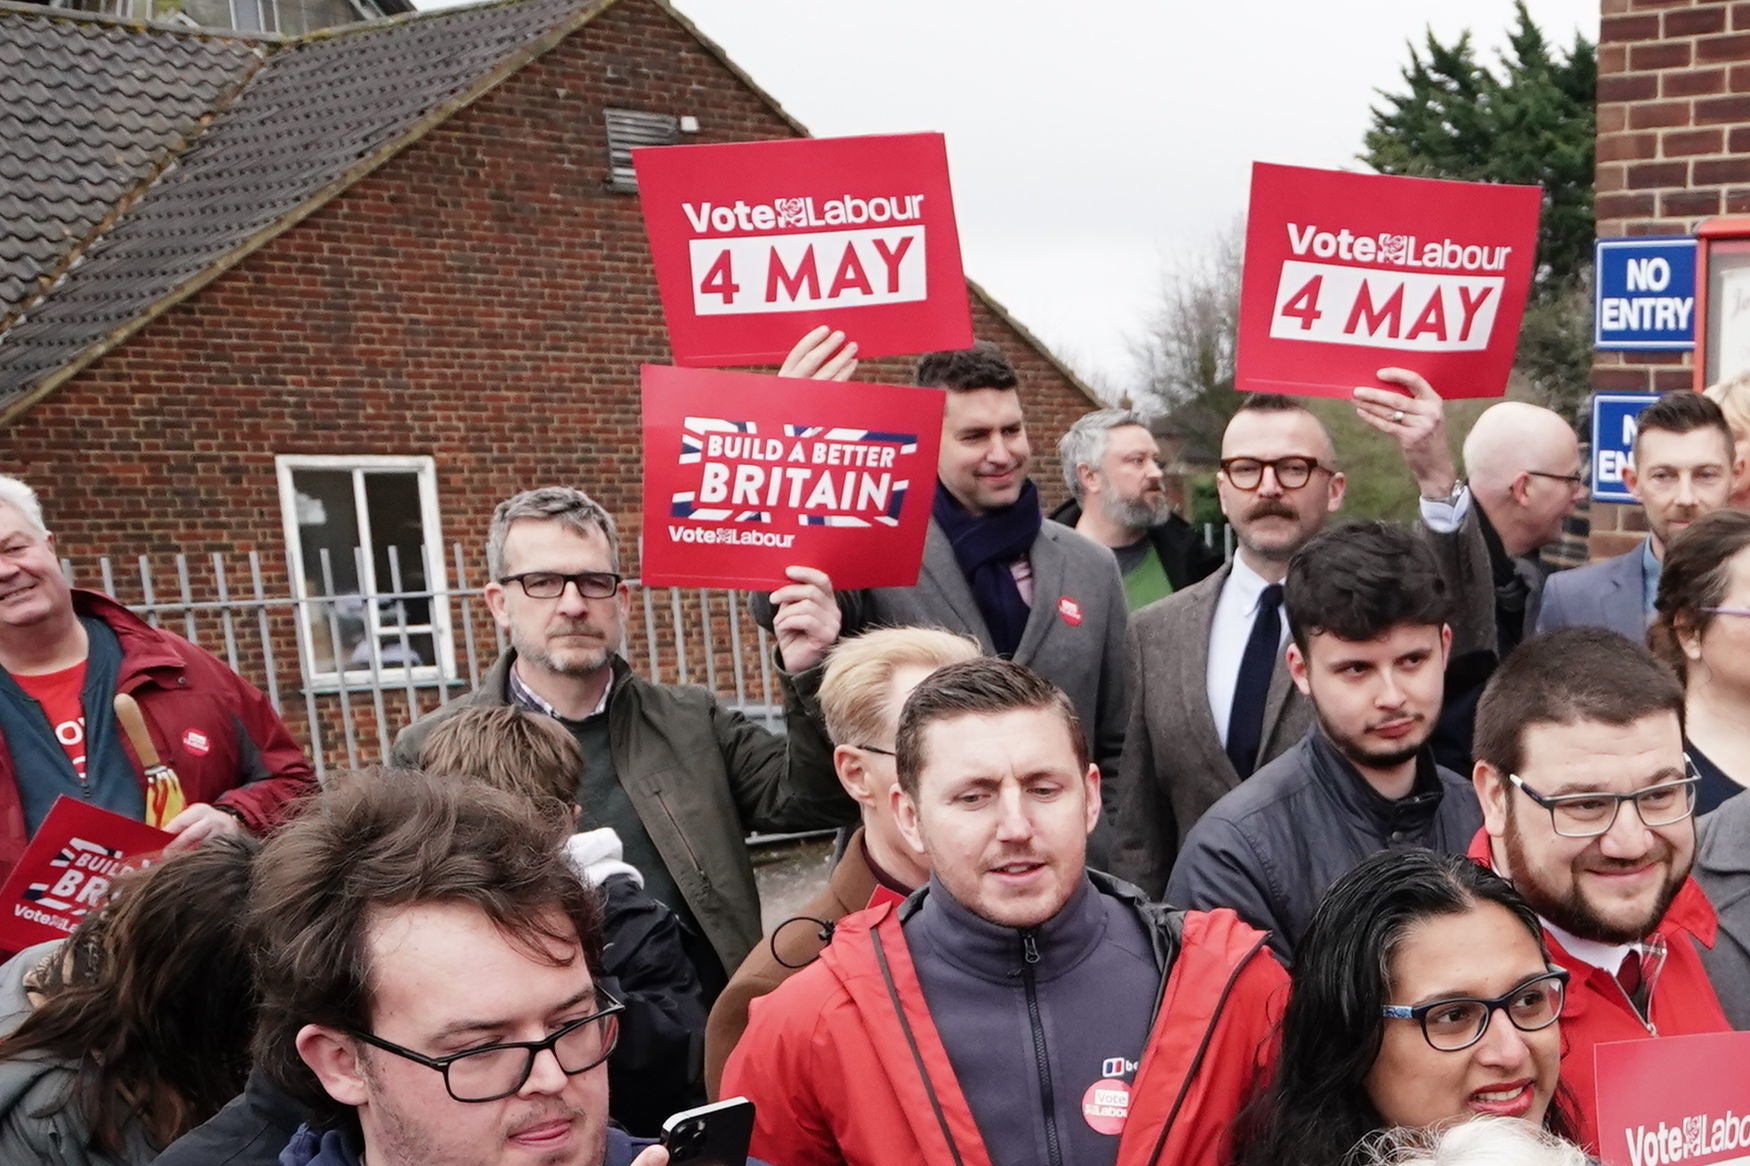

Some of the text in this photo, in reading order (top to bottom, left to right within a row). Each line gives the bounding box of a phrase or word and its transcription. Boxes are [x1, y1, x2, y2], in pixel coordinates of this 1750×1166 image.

[682, 195, 925, 233] Vote Labour
[1287, 223, 1513, 270] Vote Labour
[700, 237, 914, 304] 4 MAY
[1627, 257, 1671, 292] NO
[1281, 274, 1495, 341] 4 MAY
[1601, 297, 1694, 331] ENTRY
[707, 435, 896, 468] BUILD A BETTER
[699, 462, 892, 511] BRITAIN
[668, 526, 796, 548] Vote Labour
[13, 903, 50, 926] Vote
